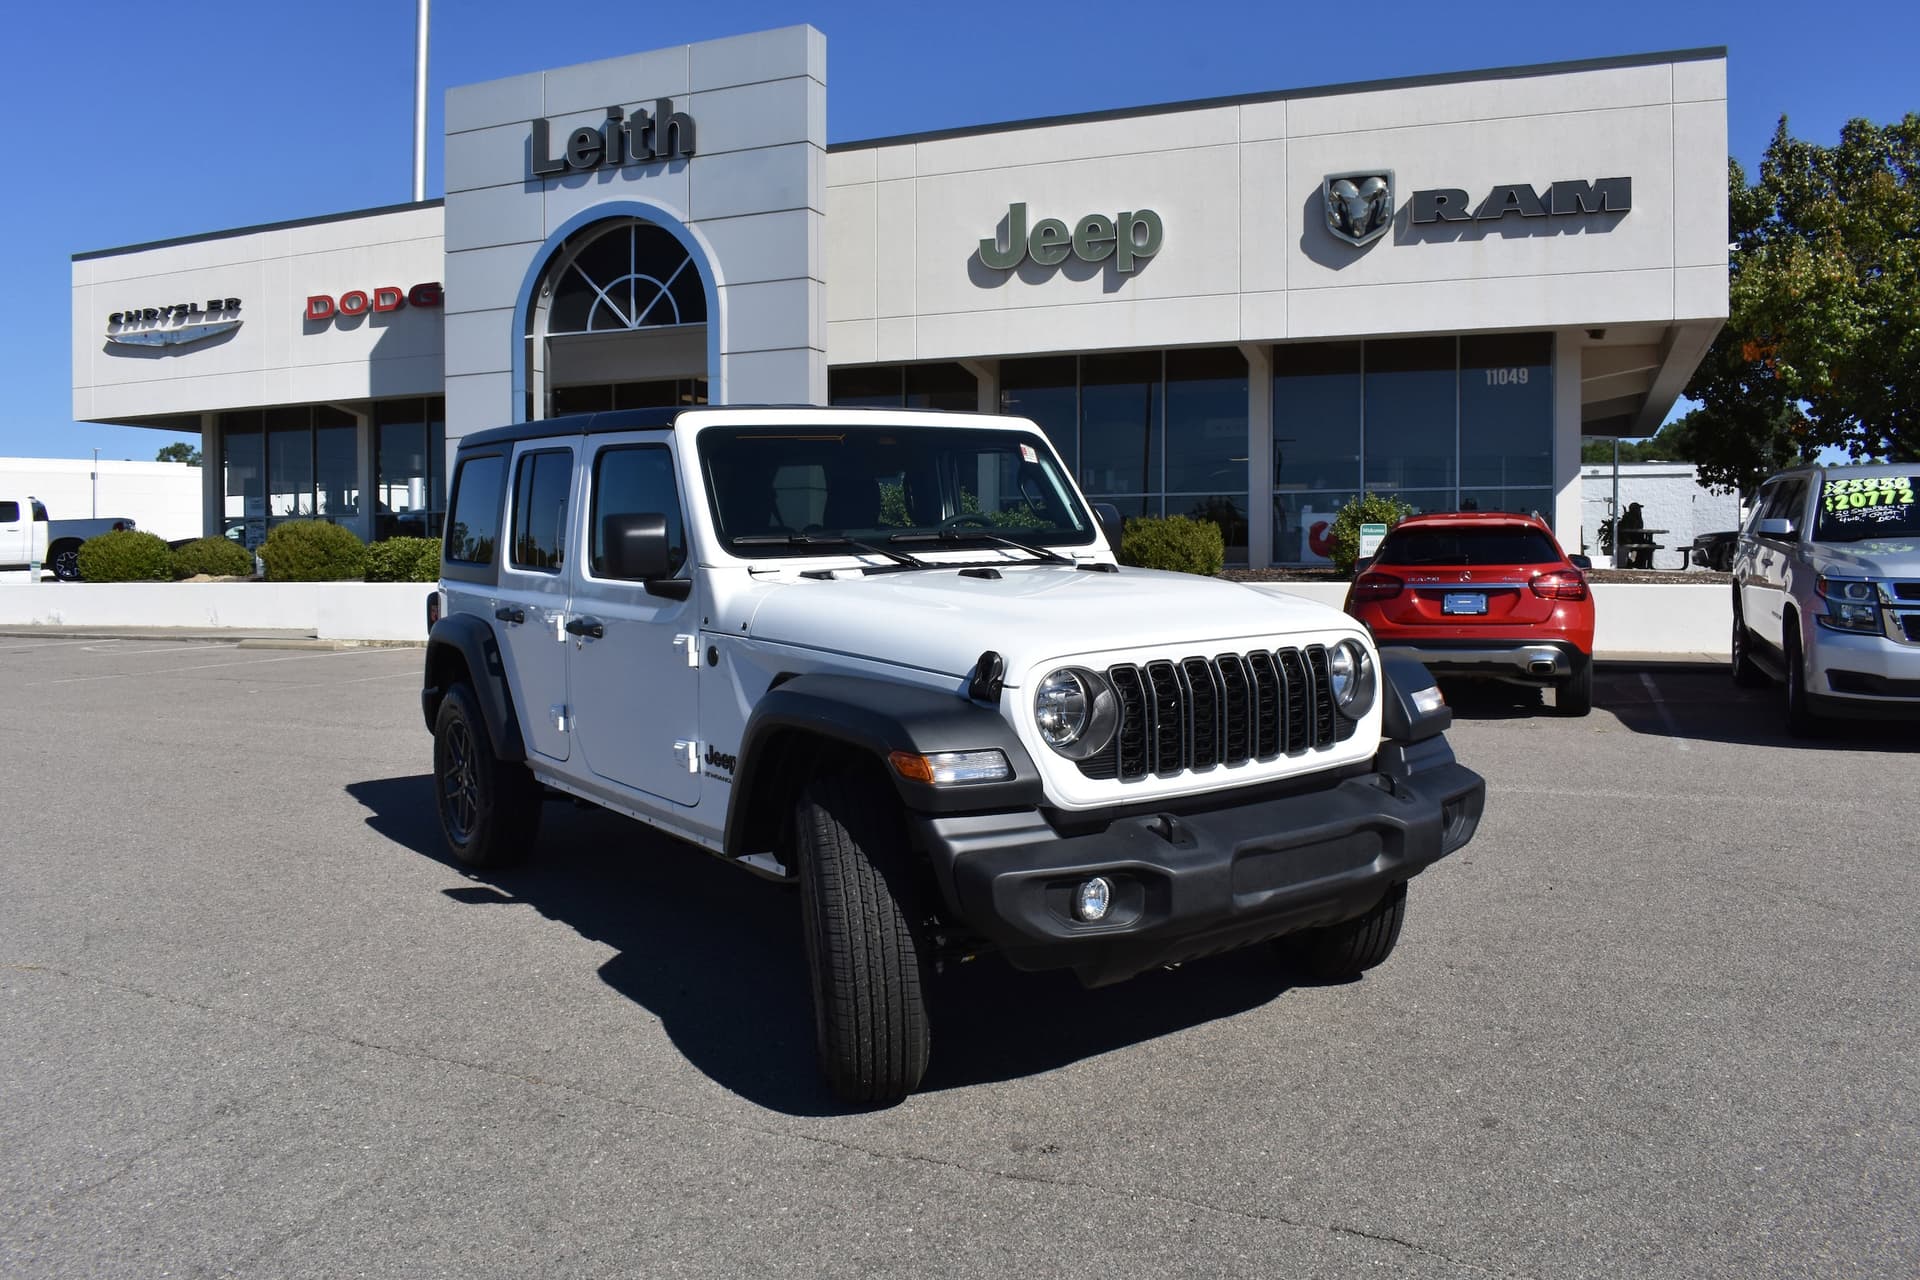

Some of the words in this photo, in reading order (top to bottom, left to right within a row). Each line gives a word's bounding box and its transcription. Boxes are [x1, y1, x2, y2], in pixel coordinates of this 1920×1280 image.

[532, 97, 697, 175] Leith
[1411, 176, 1632, 224] RAM
[978, 202, 1165, 273] Jeep
[108, 297, 242, 325] CHRYSLER
[306, 281, 443, 320] DODG
[1486, 367, 1529, 386] 11049
[1825, 489, 1914, 512] $20772
[704, 744, 736, 776] Jeep
